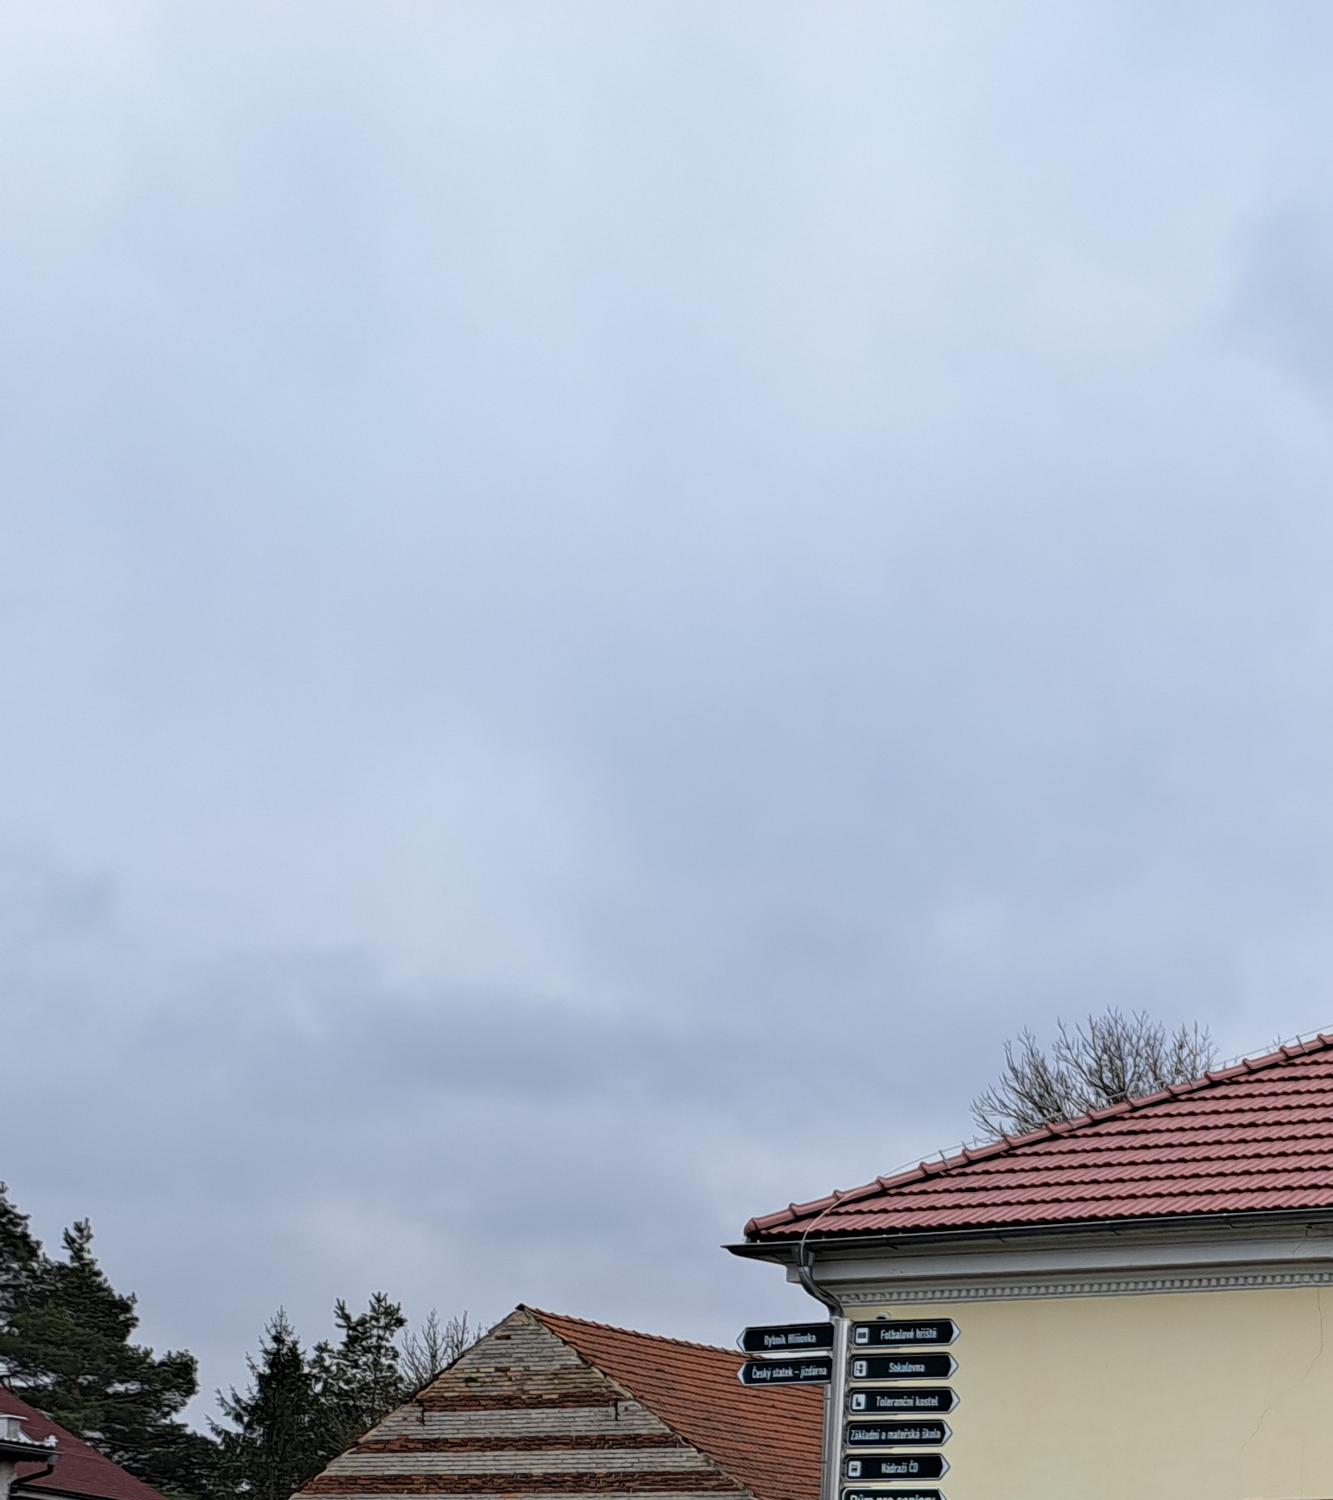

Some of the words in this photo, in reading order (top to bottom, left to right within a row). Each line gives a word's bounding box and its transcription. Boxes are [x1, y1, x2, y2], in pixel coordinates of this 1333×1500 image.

[880, 1329, 914, 1340] Fotbalové
[751, 1365, 772, 1380] Český
[773, 1367, 794, 1378] statek
[800, 1365, 828, 1379] jízdárna
[888, 1361, 926, 1373] Sokolovna
[875, 1396, 914, 1407] Toleranční
[915, 1396, 939, 1407] kostel
[850, 1429, 880, 1440] Základní
[887, 1428, 920, 1440] mateřská
[921, 1428, 941, 1439] škola
[881, 1462, 908, 1474] Nádraží
[908, 1460, 919, 1473] ČD
